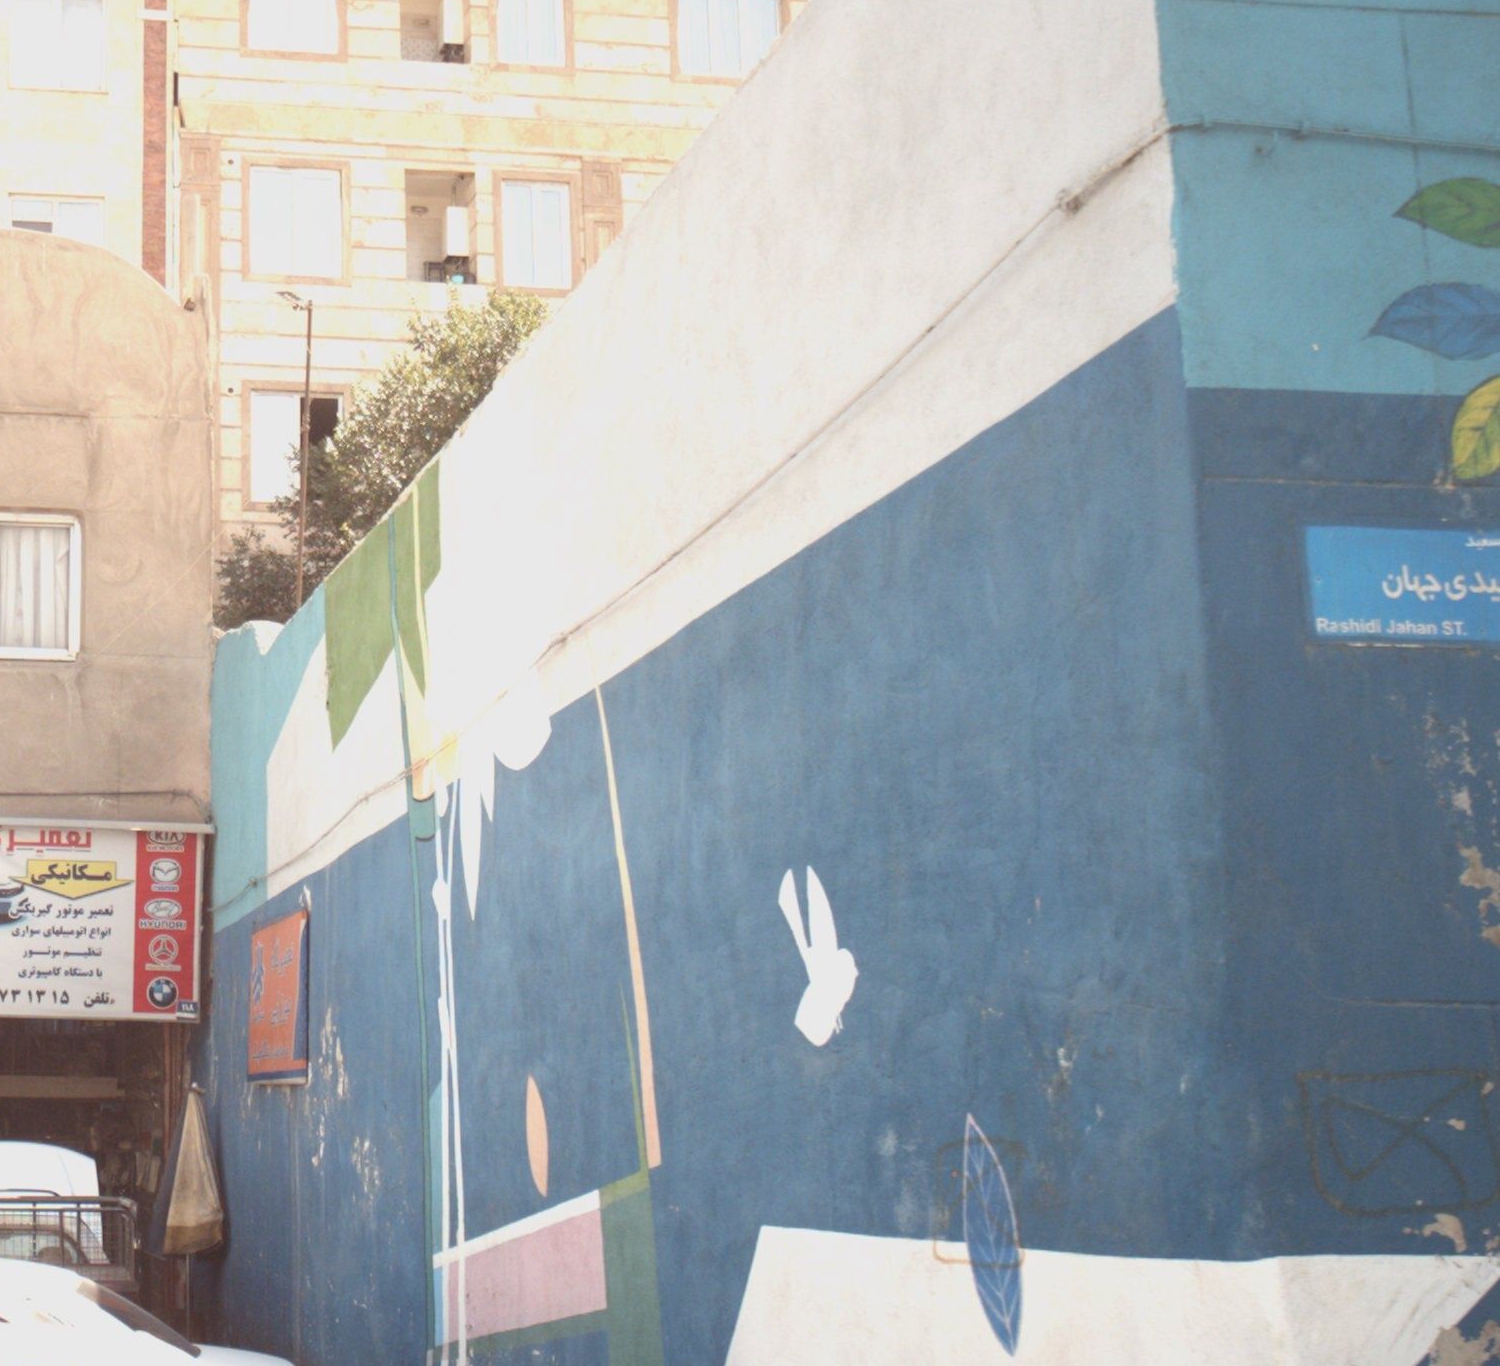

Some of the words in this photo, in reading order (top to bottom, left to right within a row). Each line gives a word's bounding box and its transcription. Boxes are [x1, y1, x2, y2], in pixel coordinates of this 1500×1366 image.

[1382, 565, 1442, 601] جهان
[1316, 618, 1381, 634] Rashidi
[1386, 620, 1437, 635] Jahan
[1442, 621, 1467, 636] ST.
[30, 863, 113, 885] مکانیکی
[56, 903, 85, 917] موتور
[88, 903, 114, 917] تعمیر
[11, 925, 41, 938] سواری
[89, 927, 112, 940] انواع
[22, 947, 62, 958] موتور
[62, 947, 103, 958] تنظیم
[18, 966, 61, 979] کامپیوتری
[63, 967, 94, 978] دستگاه
[95, 969, 104, 980] با
